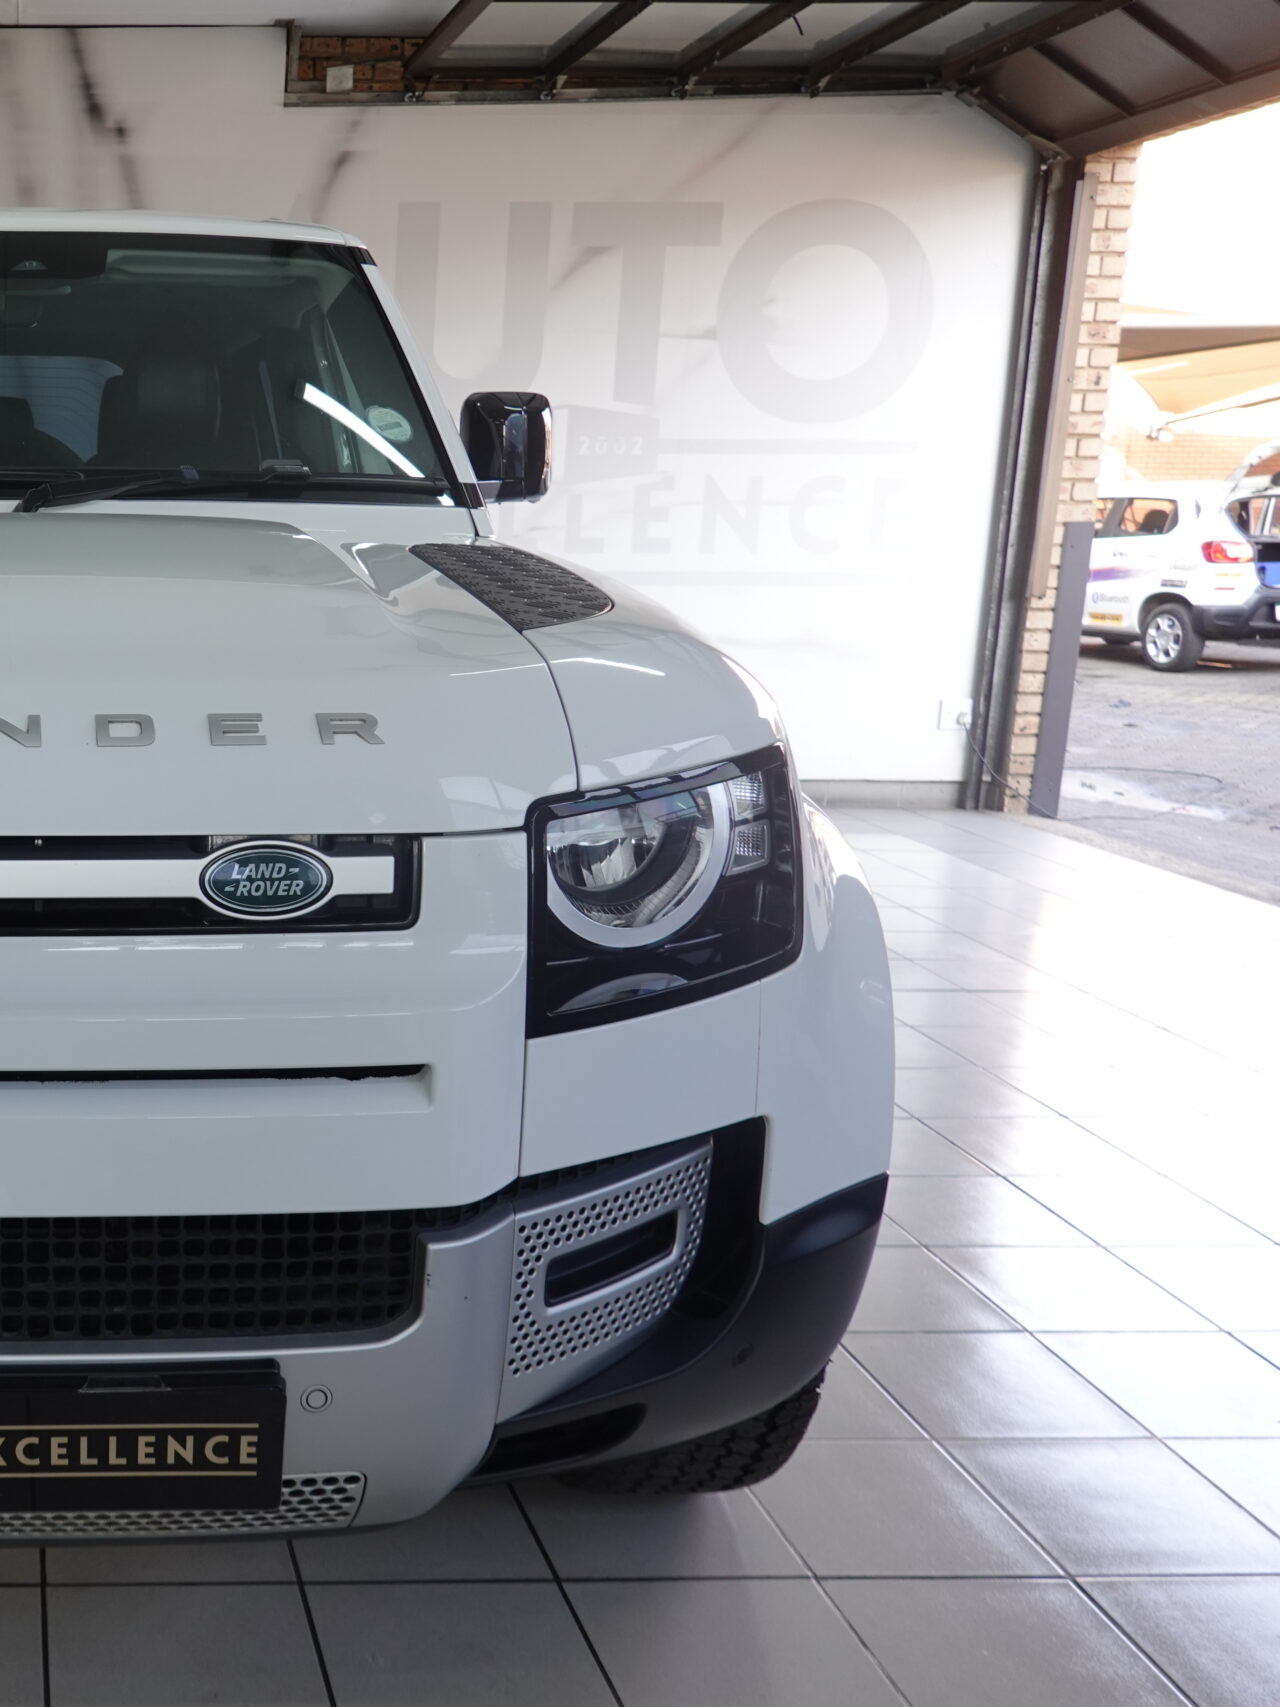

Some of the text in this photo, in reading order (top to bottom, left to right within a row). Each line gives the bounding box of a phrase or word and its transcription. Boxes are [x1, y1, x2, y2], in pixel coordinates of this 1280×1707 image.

[392, 198, 934, 425] UTO
[577, 436, 644, 457] 2002
[231, 862, 287, 880] LAND
[236, 880, 305, 897] ROVER
